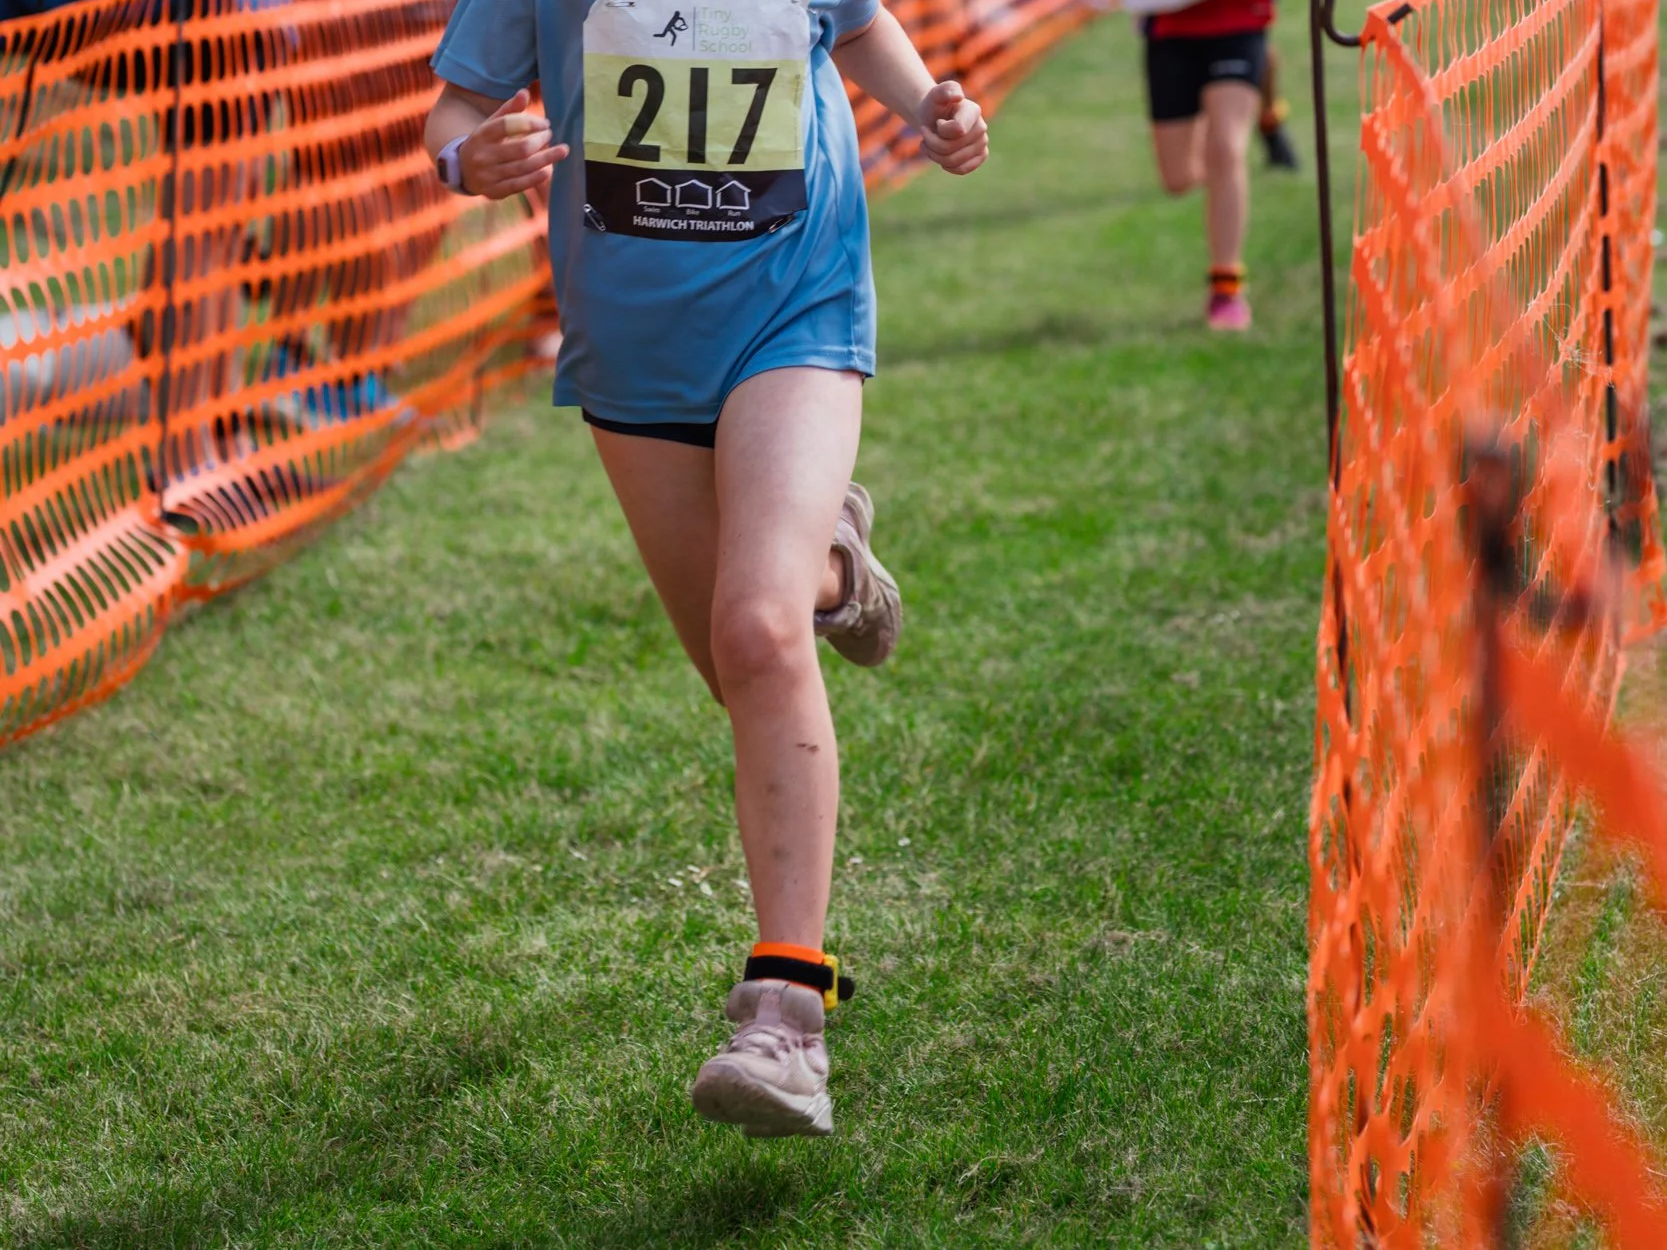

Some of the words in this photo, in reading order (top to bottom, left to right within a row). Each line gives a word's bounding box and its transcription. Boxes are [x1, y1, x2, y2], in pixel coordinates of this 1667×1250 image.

[700, 6, 732, 23] Tiny
[698, 23, 751, 40] Rugby
[699, 40, 752, 53] School
[616, 64, 778, 165] 217
[643, 206, 661, 214] Swim
[686, 208, 701, 216] Bike
[727, 209, 741, 217] Run
[633, 215, 687, 230] HARWICH
[688, 220, 754, 232] TRIATHLON
